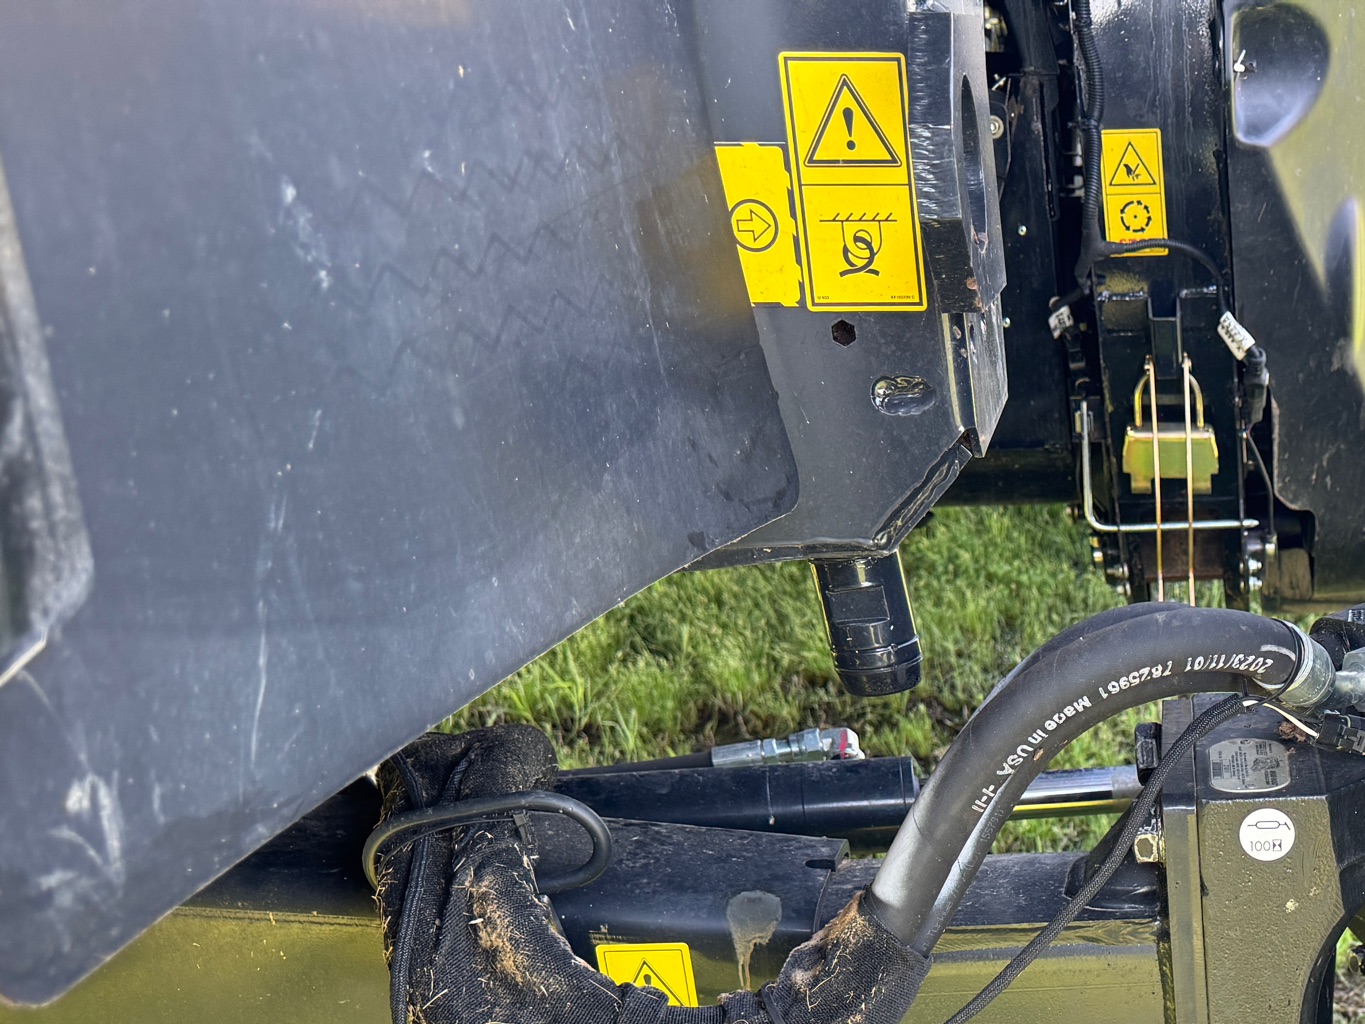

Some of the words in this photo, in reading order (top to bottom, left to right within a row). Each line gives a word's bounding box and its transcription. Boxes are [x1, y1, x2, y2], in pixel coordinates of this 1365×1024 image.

[1184, 653, 1273, 674] 2023/11/01
[1099, 661, 1172, 699] 7825961
[996, 744, 1034, 776] USA
[1250, 840, 1271, 852] 100
